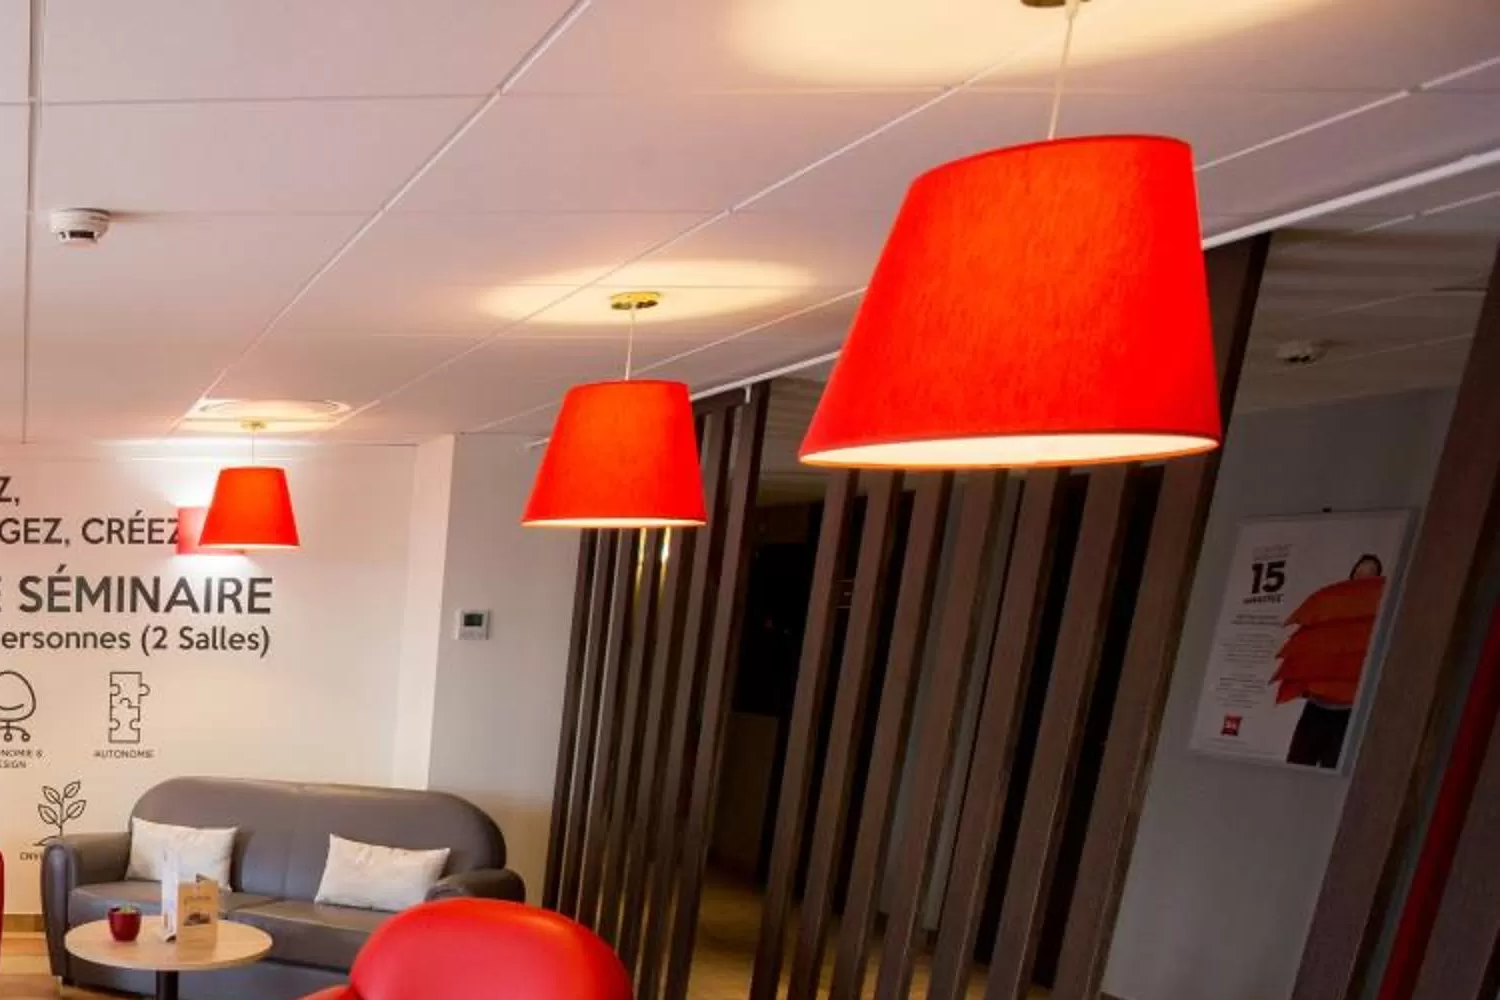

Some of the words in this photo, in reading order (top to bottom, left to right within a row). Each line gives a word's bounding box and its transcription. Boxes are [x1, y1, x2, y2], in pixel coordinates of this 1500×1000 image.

[18, 563, 273, 615] SÉMINAIRE
[1251, 560, 1286, 594] 15
[141, 624, 168, 656] (2
[179, 625, 270, 658] Salles)
